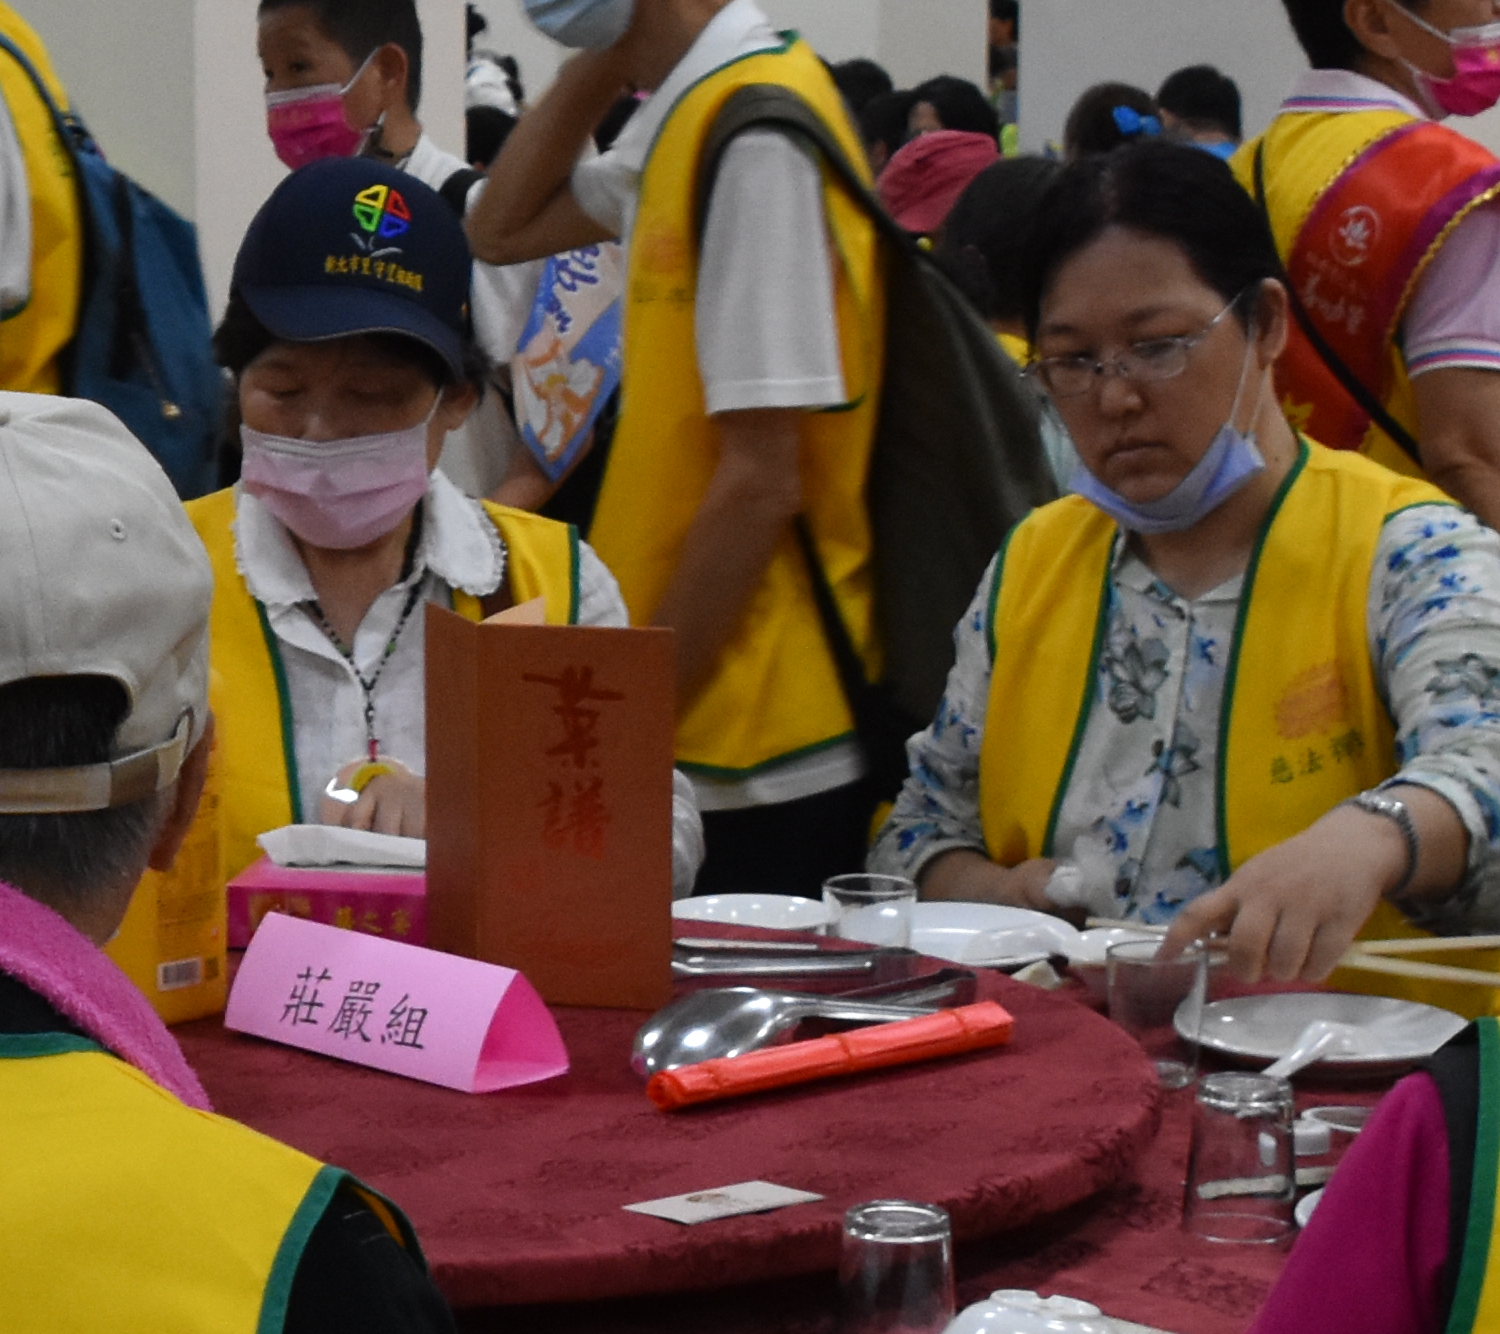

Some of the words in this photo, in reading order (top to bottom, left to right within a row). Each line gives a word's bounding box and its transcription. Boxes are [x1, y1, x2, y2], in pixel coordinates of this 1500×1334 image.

[522, 666, 628, 860] 菜譜
[280, 966, 428, 1049] 莊嚴組
